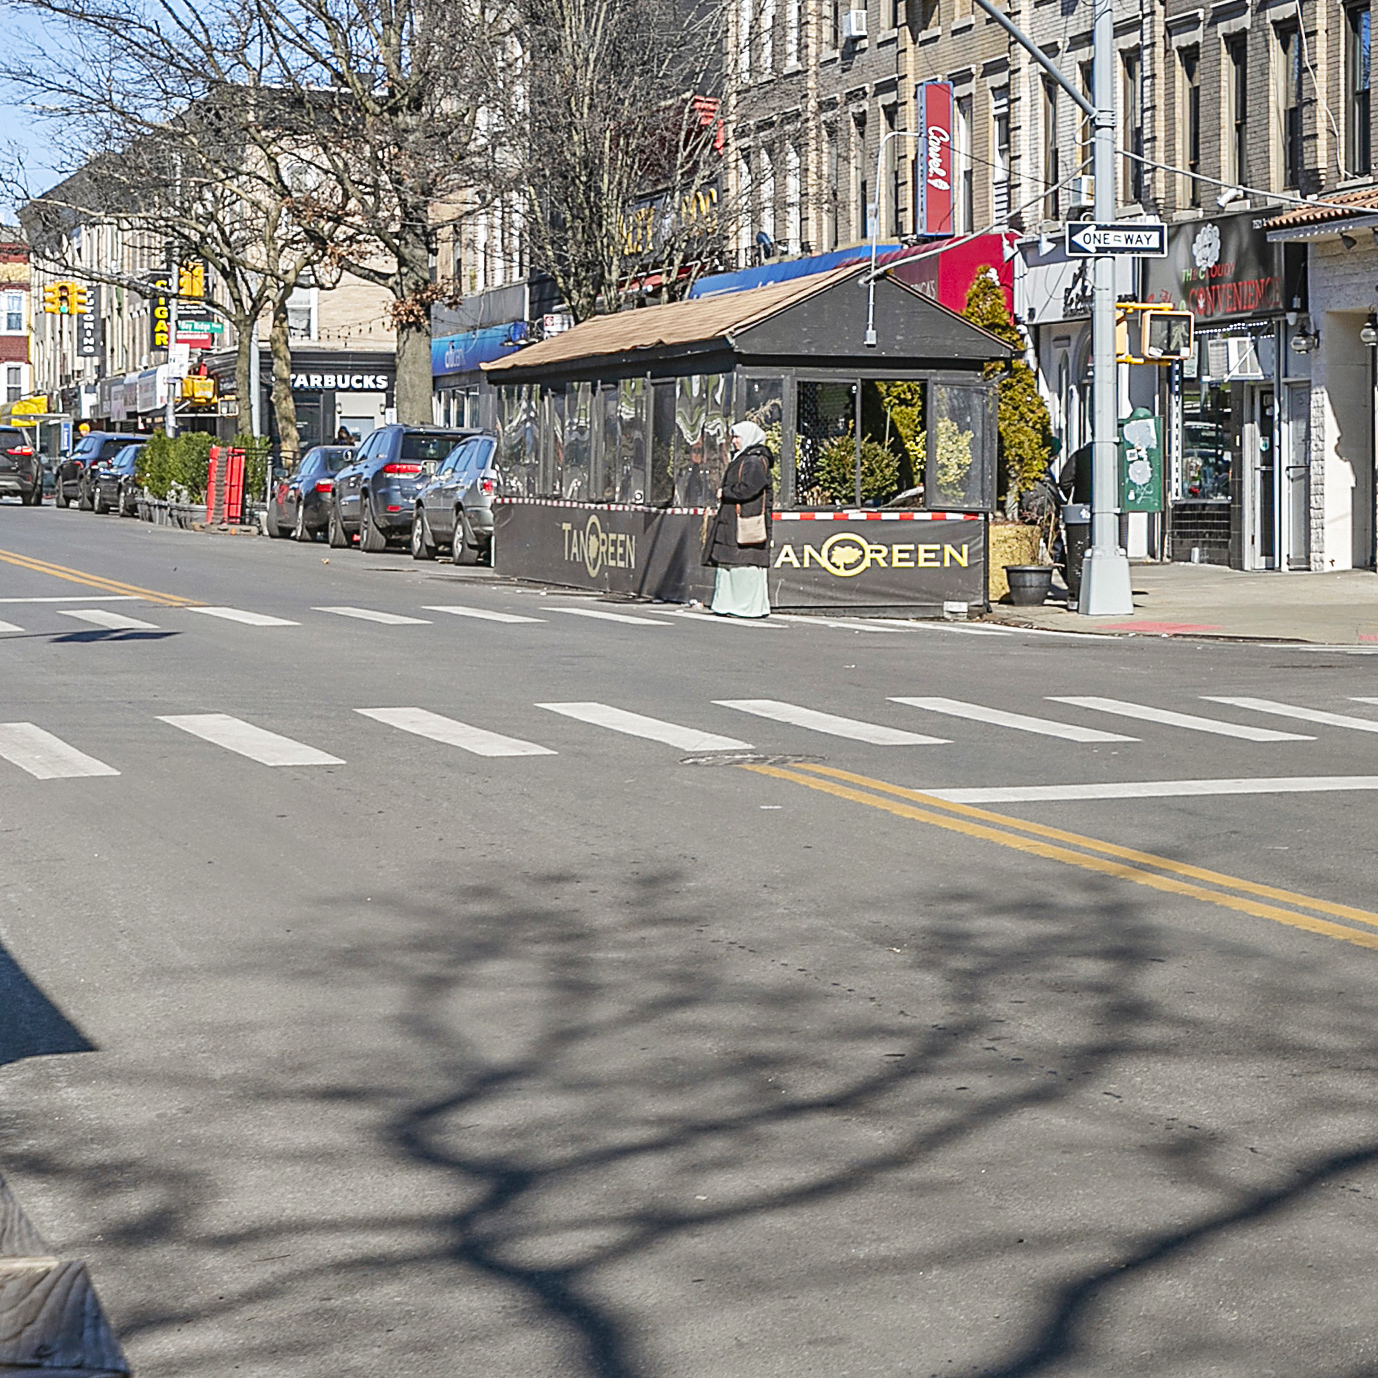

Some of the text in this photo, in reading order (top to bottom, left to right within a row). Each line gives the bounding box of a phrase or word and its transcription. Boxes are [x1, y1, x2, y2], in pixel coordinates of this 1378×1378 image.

[1083, 232, 1153, 246] ONE WAY
[154, 280, 169, 346] CIGAR
[1189, 277, 1282, 315] CONVENIENCE
[290, 373, 389, 389] ARBUCKS
[772, 532, 969, 577] ANOREEN
